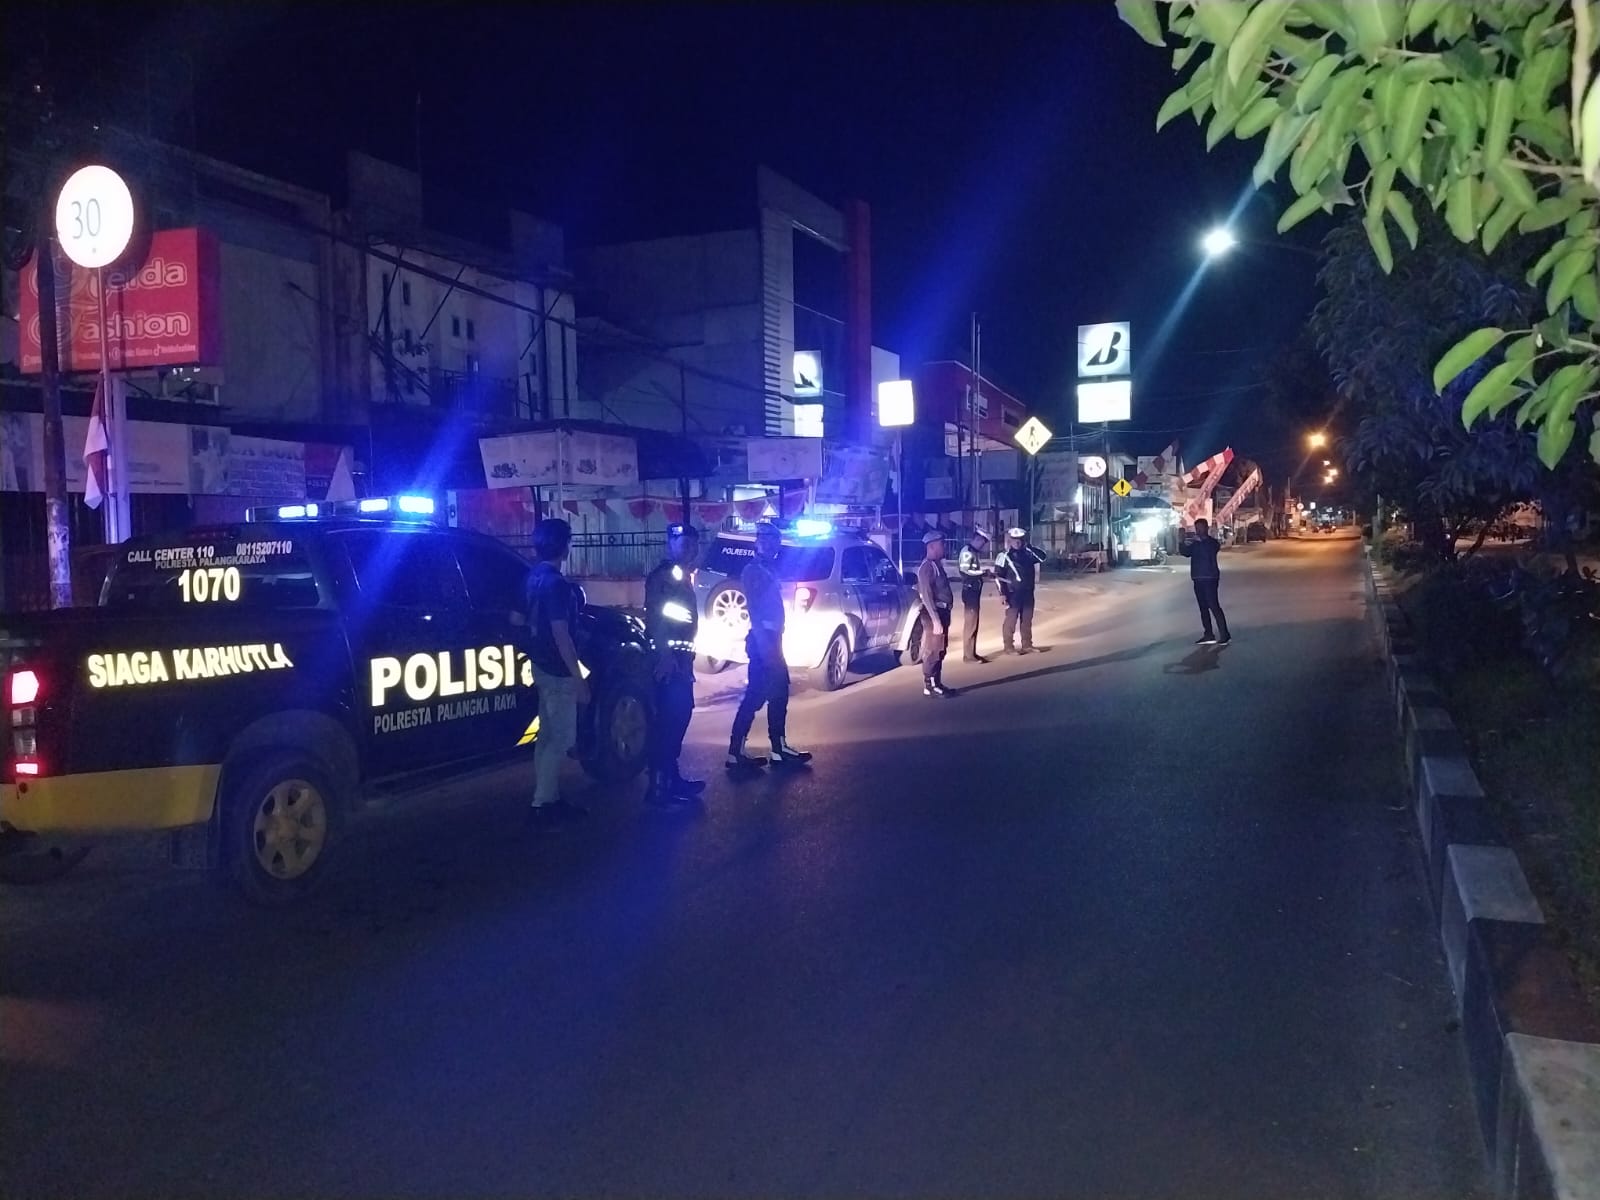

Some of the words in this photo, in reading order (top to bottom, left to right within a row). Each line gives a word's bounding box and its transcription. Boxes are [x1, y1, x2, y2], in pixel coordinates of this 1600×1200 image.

[71, 198, 102, 240] 30
[127, 551, 153, 563] CALL
[154, 547, 194, 561] CENTER
[196, 546, 215, 558] 110
[155, 558, 197, 570] POLRESTA
[721, 546, 756, 558] POLRESTA
[178, 566, 241, 603] 1070
[87, 650, 169, 688] SIAGA
[172, 642, 294, 680] KARHUTLA
[370, 644, 516, 707] POLISI
[374, 706, 432, 735] POLRESTA
[437, 697, 490, 722] PALANGKA
[493, 692, 517, 711] RAYA
